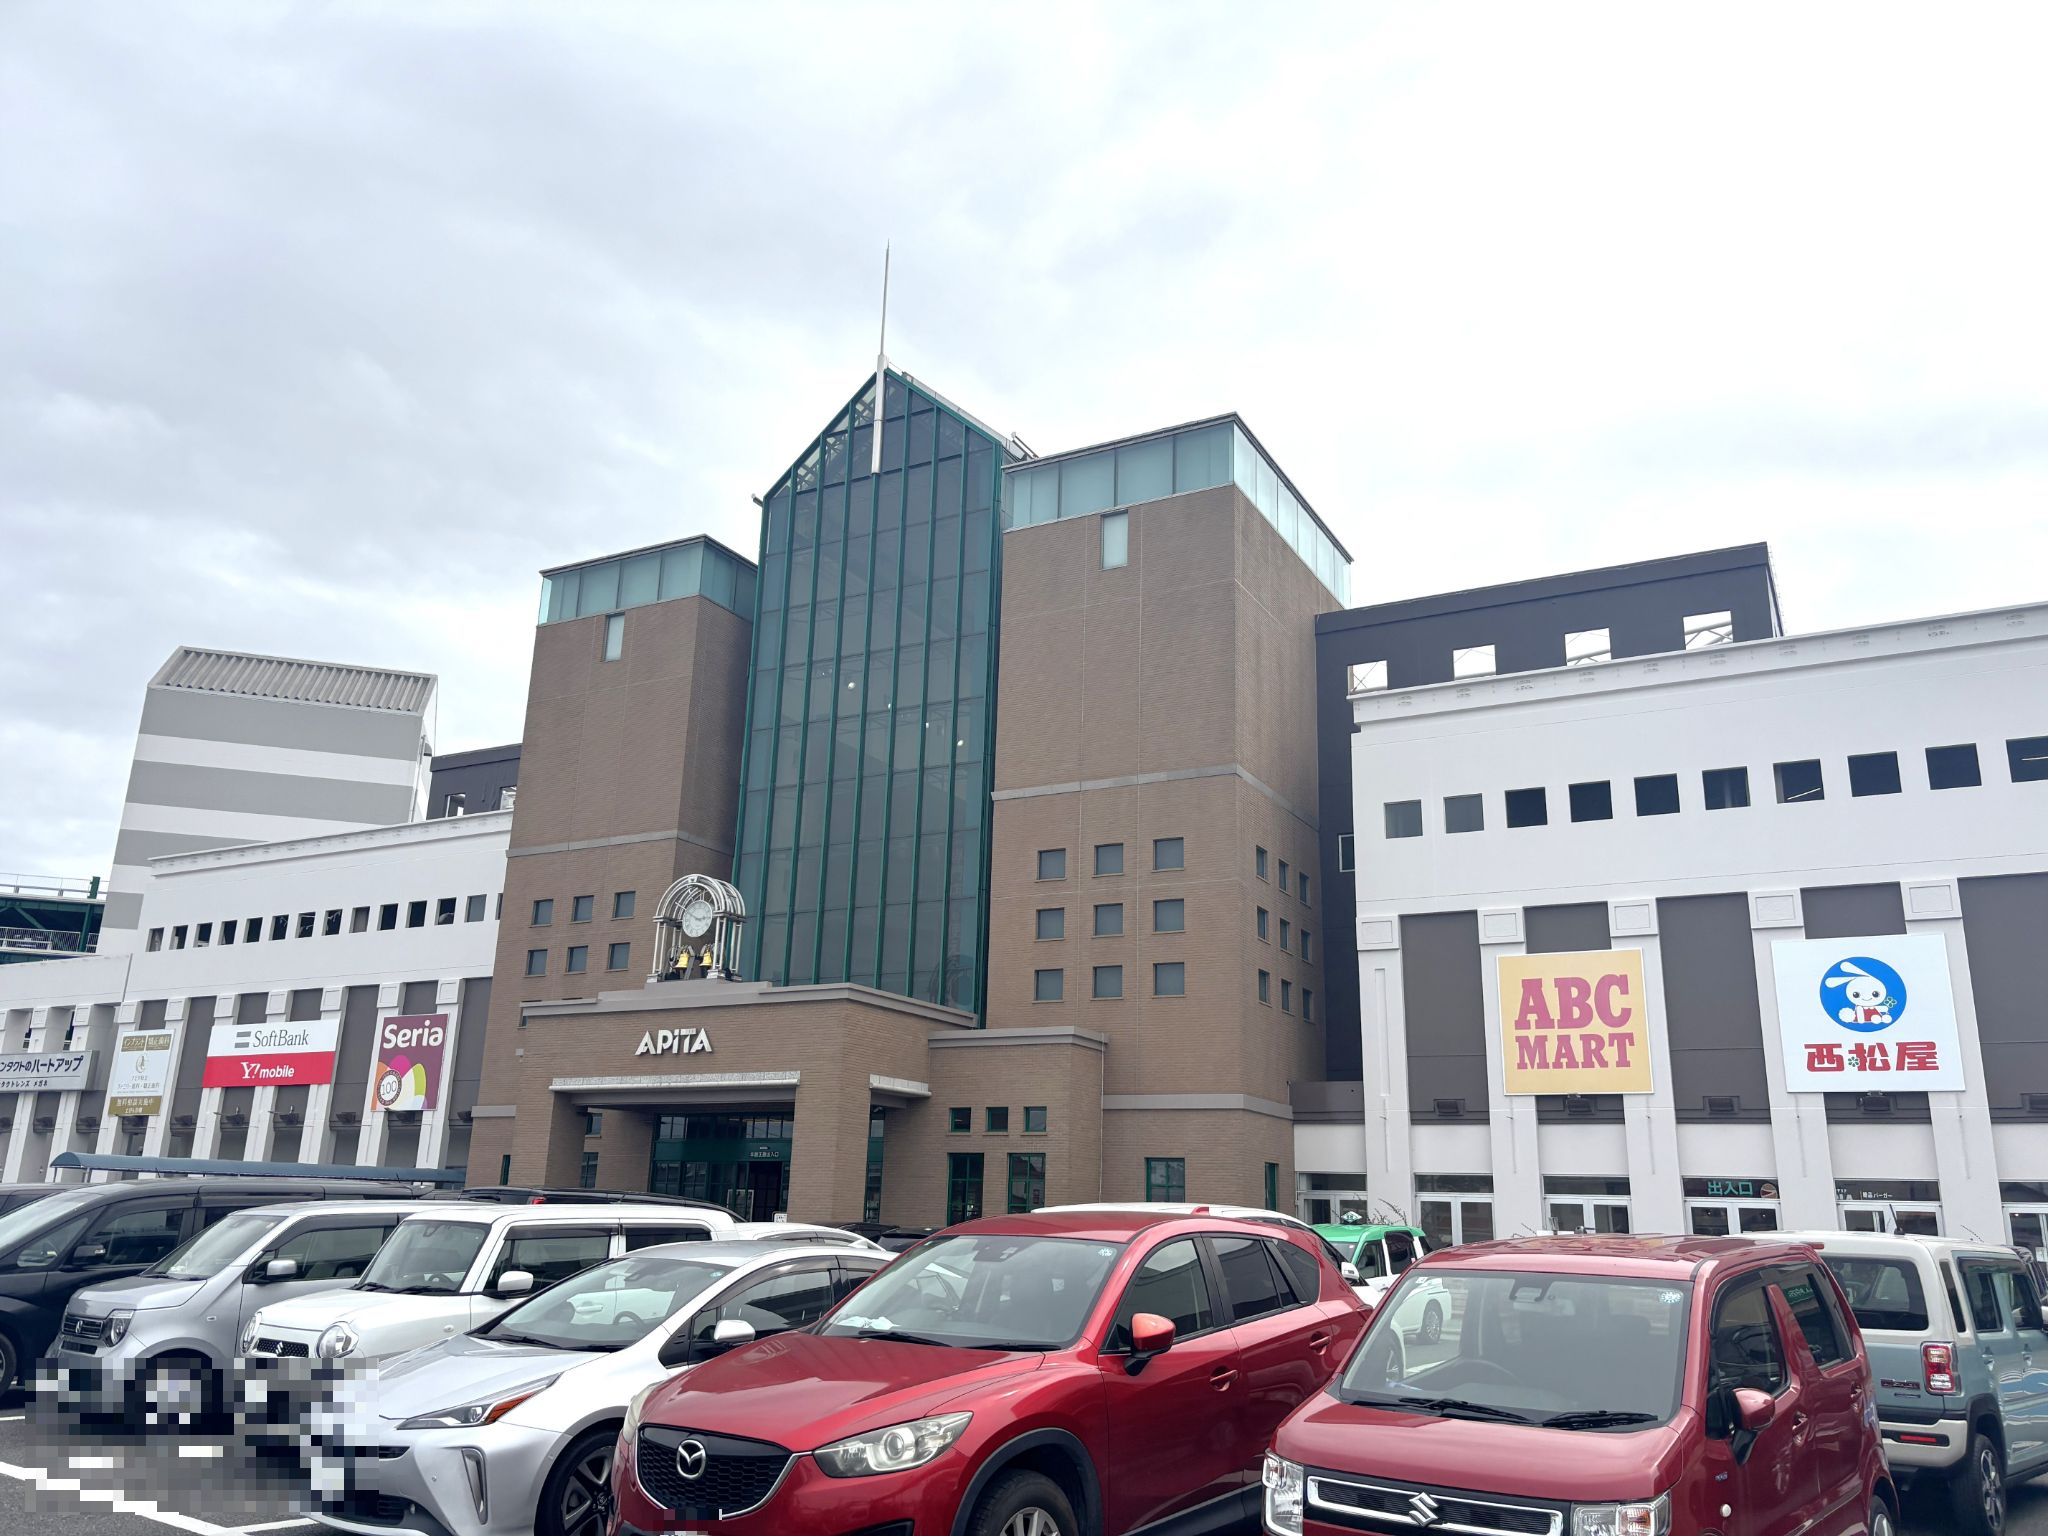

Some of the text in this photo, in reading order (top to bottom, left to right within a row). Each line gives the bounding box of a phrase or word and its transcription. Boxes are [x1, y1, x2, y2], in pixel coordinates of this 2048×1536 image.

[1514, 974, 1632, 1030] ABC
[253, 1029, 309, 1048] SoftBank
[383, 1020, 443, 1049] Seria
[1515, 1032, 1635, 1070] MART
[1804, 1041, 1939, 1072] 西松屋
[0, 1080, 30, 1088] タクトレンズ
[1707, 1181, 1753, 1196] 出入口
